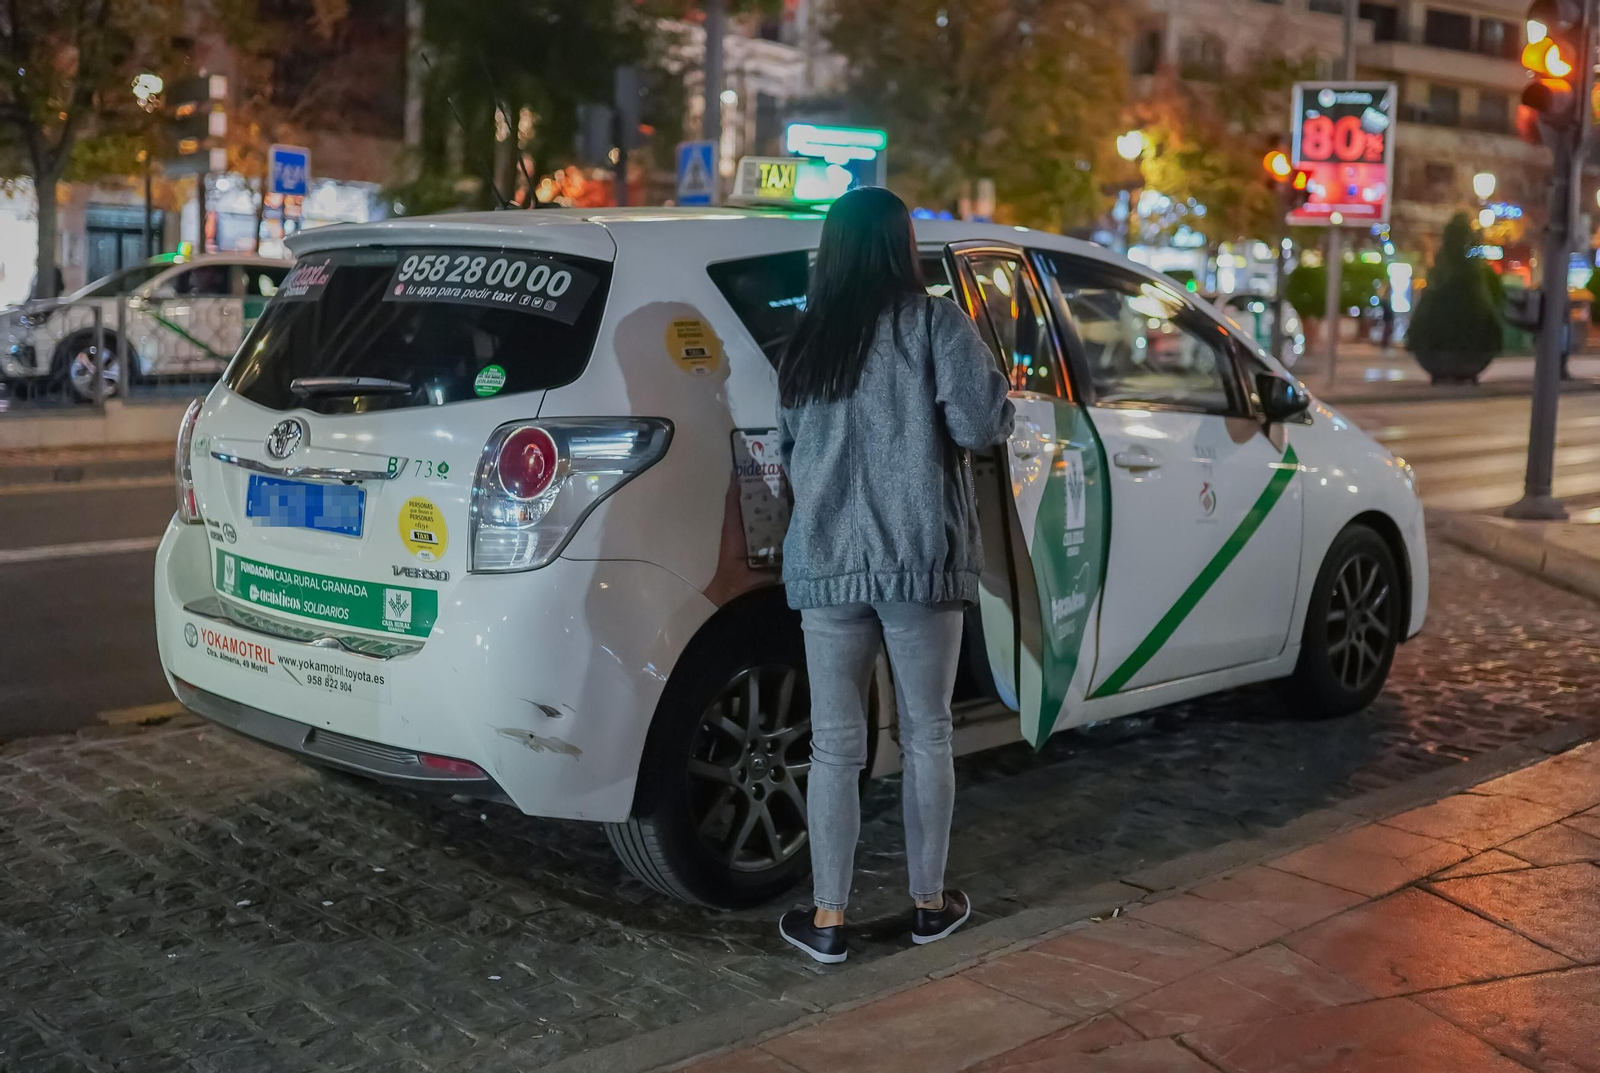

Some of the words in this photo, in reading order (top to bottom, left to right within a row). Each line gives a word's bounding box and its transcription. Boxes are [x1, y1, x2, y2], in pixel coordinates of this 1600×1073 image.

[760, 163, 796, 188] TAXI
[406, 284, 418, 295] tu
[416, 286, 437, 297] app
[436, 286, 462, 297] para
[461, 287, 492, 299] pedir
[491, 289, 517, 303] taxi
[386, 457, 398, 473] B
[414, 460, 433, 478] 73
[409, 501, 433, 510] PERSONAS
[410, 514, 434, 522] PERSONAS
[240, 561, 275, 579] FUNDACIÓN
[274, 570, 292, 585] CAJA
[293, 574, 320, 590] RURAL
[321, 579, 368, 598] GRANADA
[303, 600, 350, 620] SOLIDARIOS
[201, 628, 275, 665] YOKAMOTRIL
[206, 647, 218, 658] Ctra.
[242, 659, 250, 668] 49
[251, 661, 269, 674] Motril
[277, 654, 385, 685] www.yokamotril.toyota.es
[307, 674, 322, 686] 958
[324, 676, 338, 690] 822
[339, 680, 352, 693] 904
